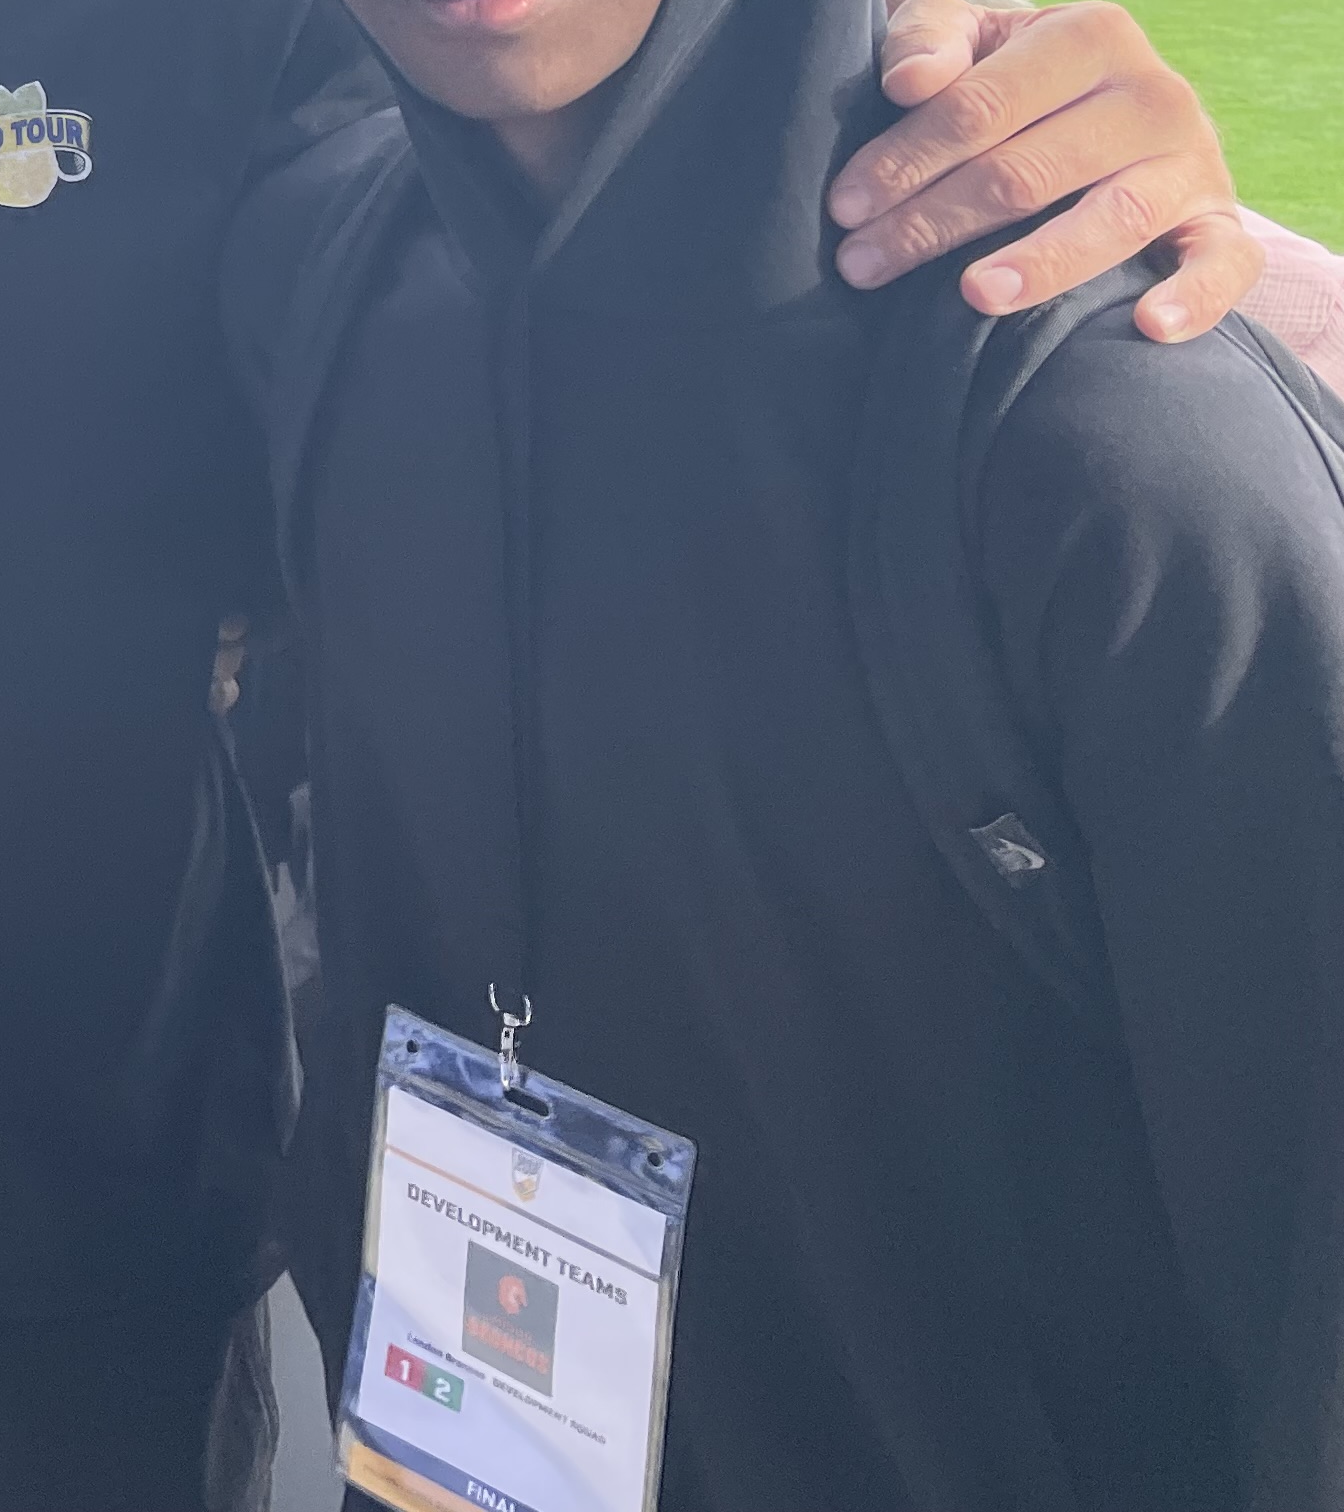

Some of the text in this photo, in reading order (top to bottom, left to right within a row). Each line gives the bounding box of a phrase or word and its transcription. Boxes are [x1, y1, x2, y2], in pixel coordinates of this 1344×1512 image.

[10, 116, 85, 148] TOUR
[407, 1182, 628, 1306] DEVELOPMENT TEAMS
[400, 1359, 410, 1381] 1
[433, 1377, 452, 1403] 2
